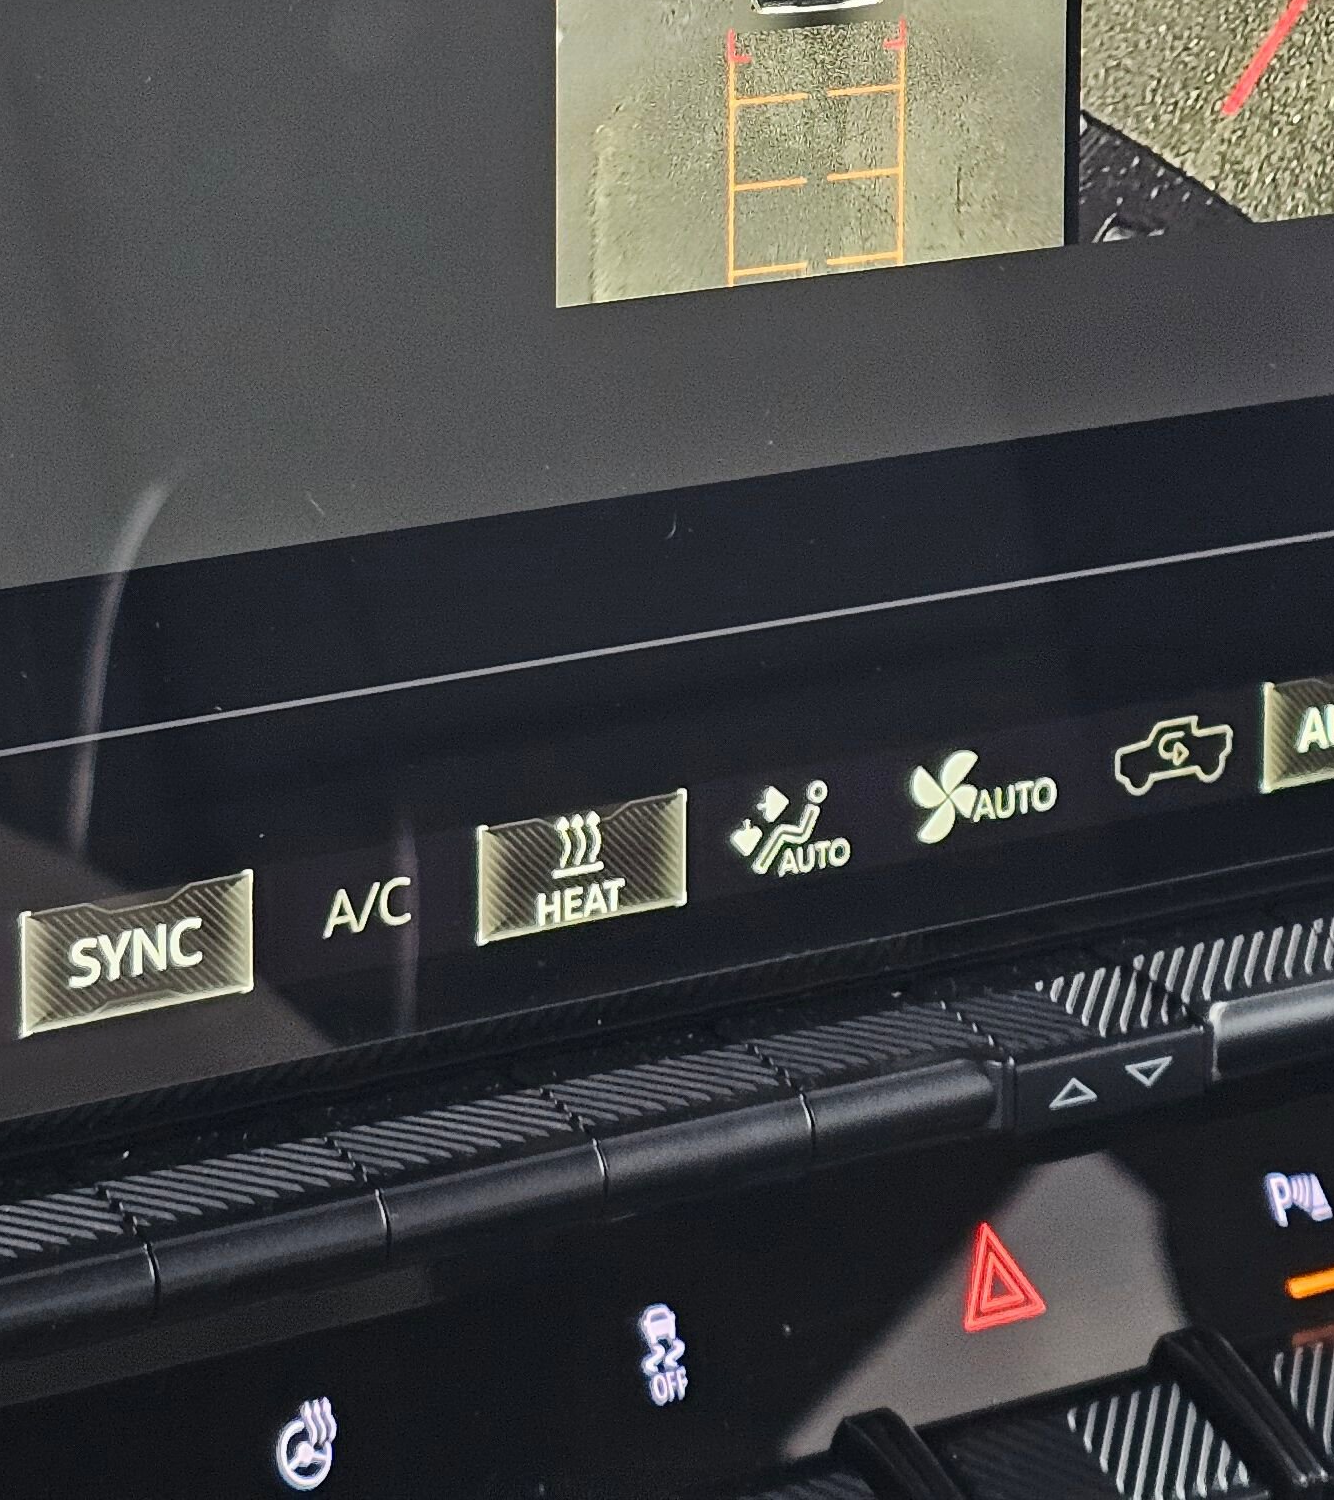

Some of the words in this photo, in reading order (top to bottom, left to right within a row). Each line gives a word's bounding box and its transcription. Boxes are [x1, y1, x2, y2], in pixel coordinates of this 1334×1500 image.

[971, 776, 1058, 823] AUTO
[778, 837, 851, 877] AUTO
[320, 876, 412, 939] A/C
[536, 876, 627, 927] HEAT
[68, 916, 203, 989] SYNC
[649, 1366, 689, 1406] OFF
